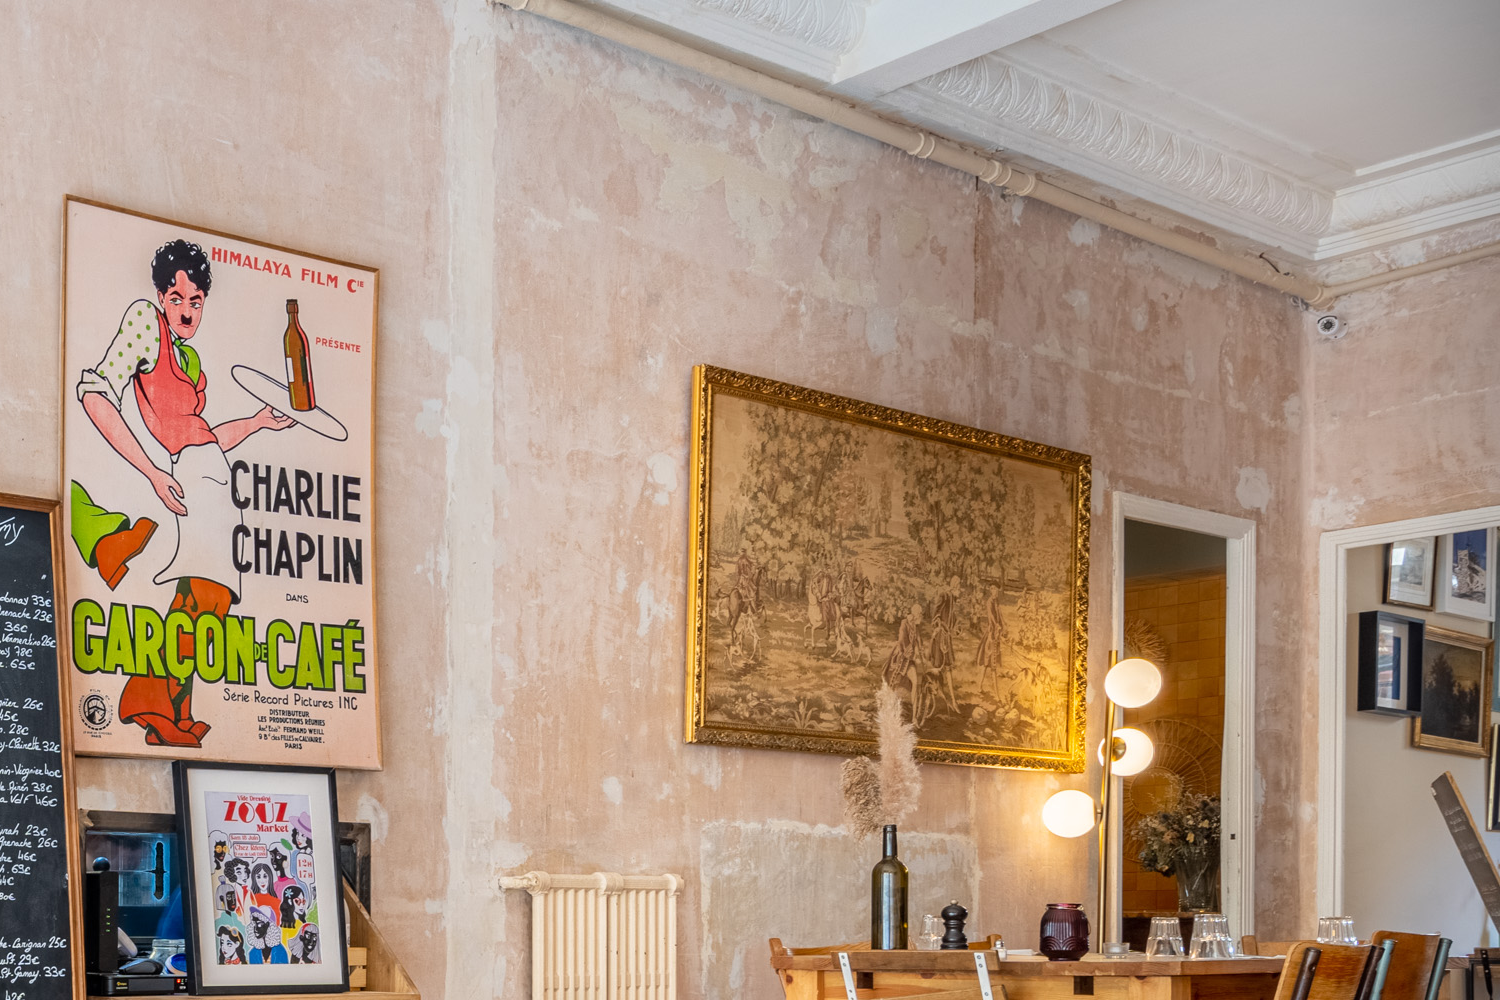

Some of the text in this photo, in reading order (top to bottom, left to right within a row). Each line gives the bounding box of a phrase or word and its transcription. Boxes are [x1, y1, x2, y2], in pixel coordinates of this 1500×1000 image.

[212, 247, 291, 278] HIMALAYA
[301, 268, 338, 288] FILM
[316, 337, 361, 353] PRÉSENTE
[231, 460, 361, 522] CHARLIE
[232, 524, 362, 585] CHAPLIN
[31, 595, 51, 607] 33€
[286, 594, 308, 603] DANS
[33, 609, 52, 622] 23€
[72, 599, 366, 693] GARÇON DE CAFÉ
[10, 659, 35, 670] 65€
[23, 698, 43, 710] 26€
[224, 688, 358, 710] Série Record Pictures INC
[270, 709, 309, 717] DISTRIBUTEUR
[223, 801, 289, 823] ZOUZ
[25, 824, 48, 836] 23€
[257, 824, 288, 832] Market
[38, 838, 58, 848] 26€
[49, 936, 67, 949] 25€
